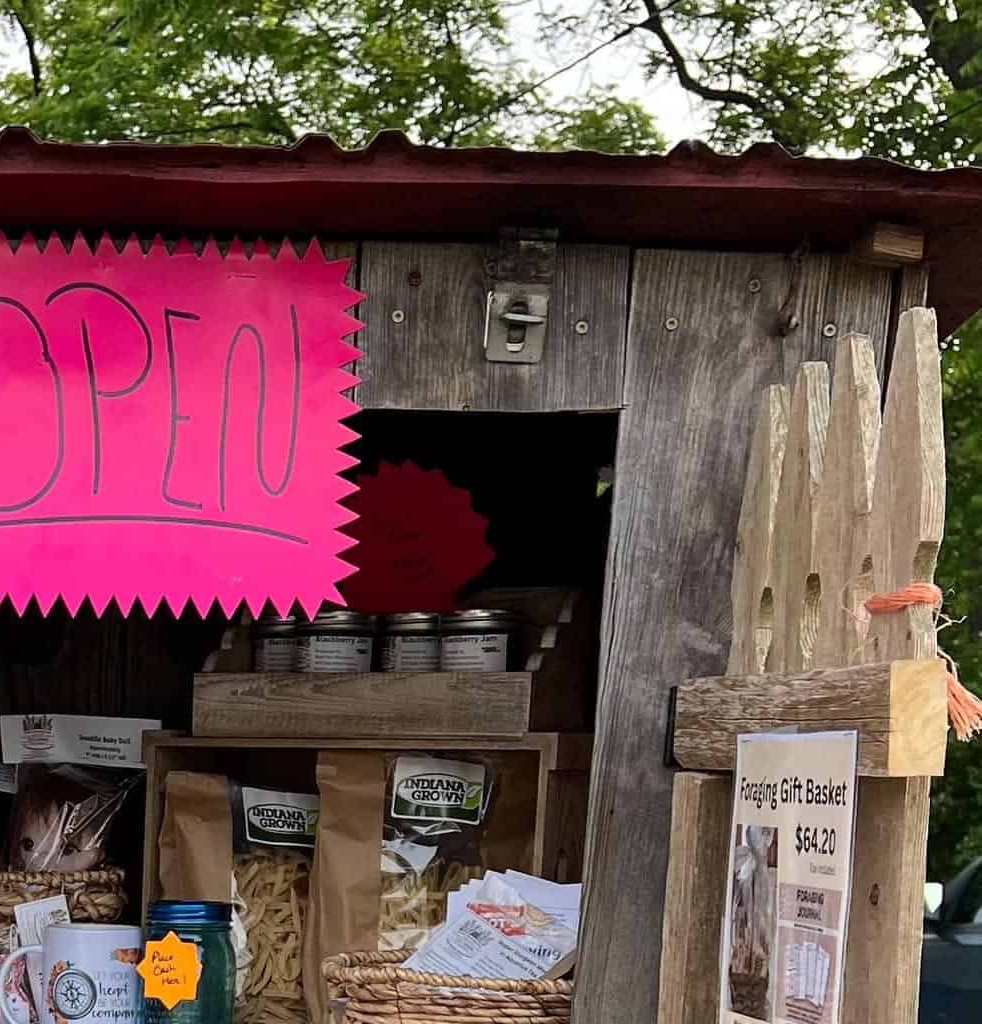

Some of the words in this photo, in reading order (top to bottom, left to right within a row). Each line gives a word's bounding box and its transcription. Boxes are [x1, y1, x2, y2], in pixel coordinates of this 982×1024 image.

[404, 778, 465, 793] INDIANA
[739, 777, 778, 810] Foraging
[780, 776, 803, 804] Gift
[805, 778, 847, 807] Basket
[411, 790, 465, 803] GROWN
[251, 806, 306, 821] INDIANA
[259, 817, 306, 831] GROWN
[795, 823, 836, 857] $64.20
